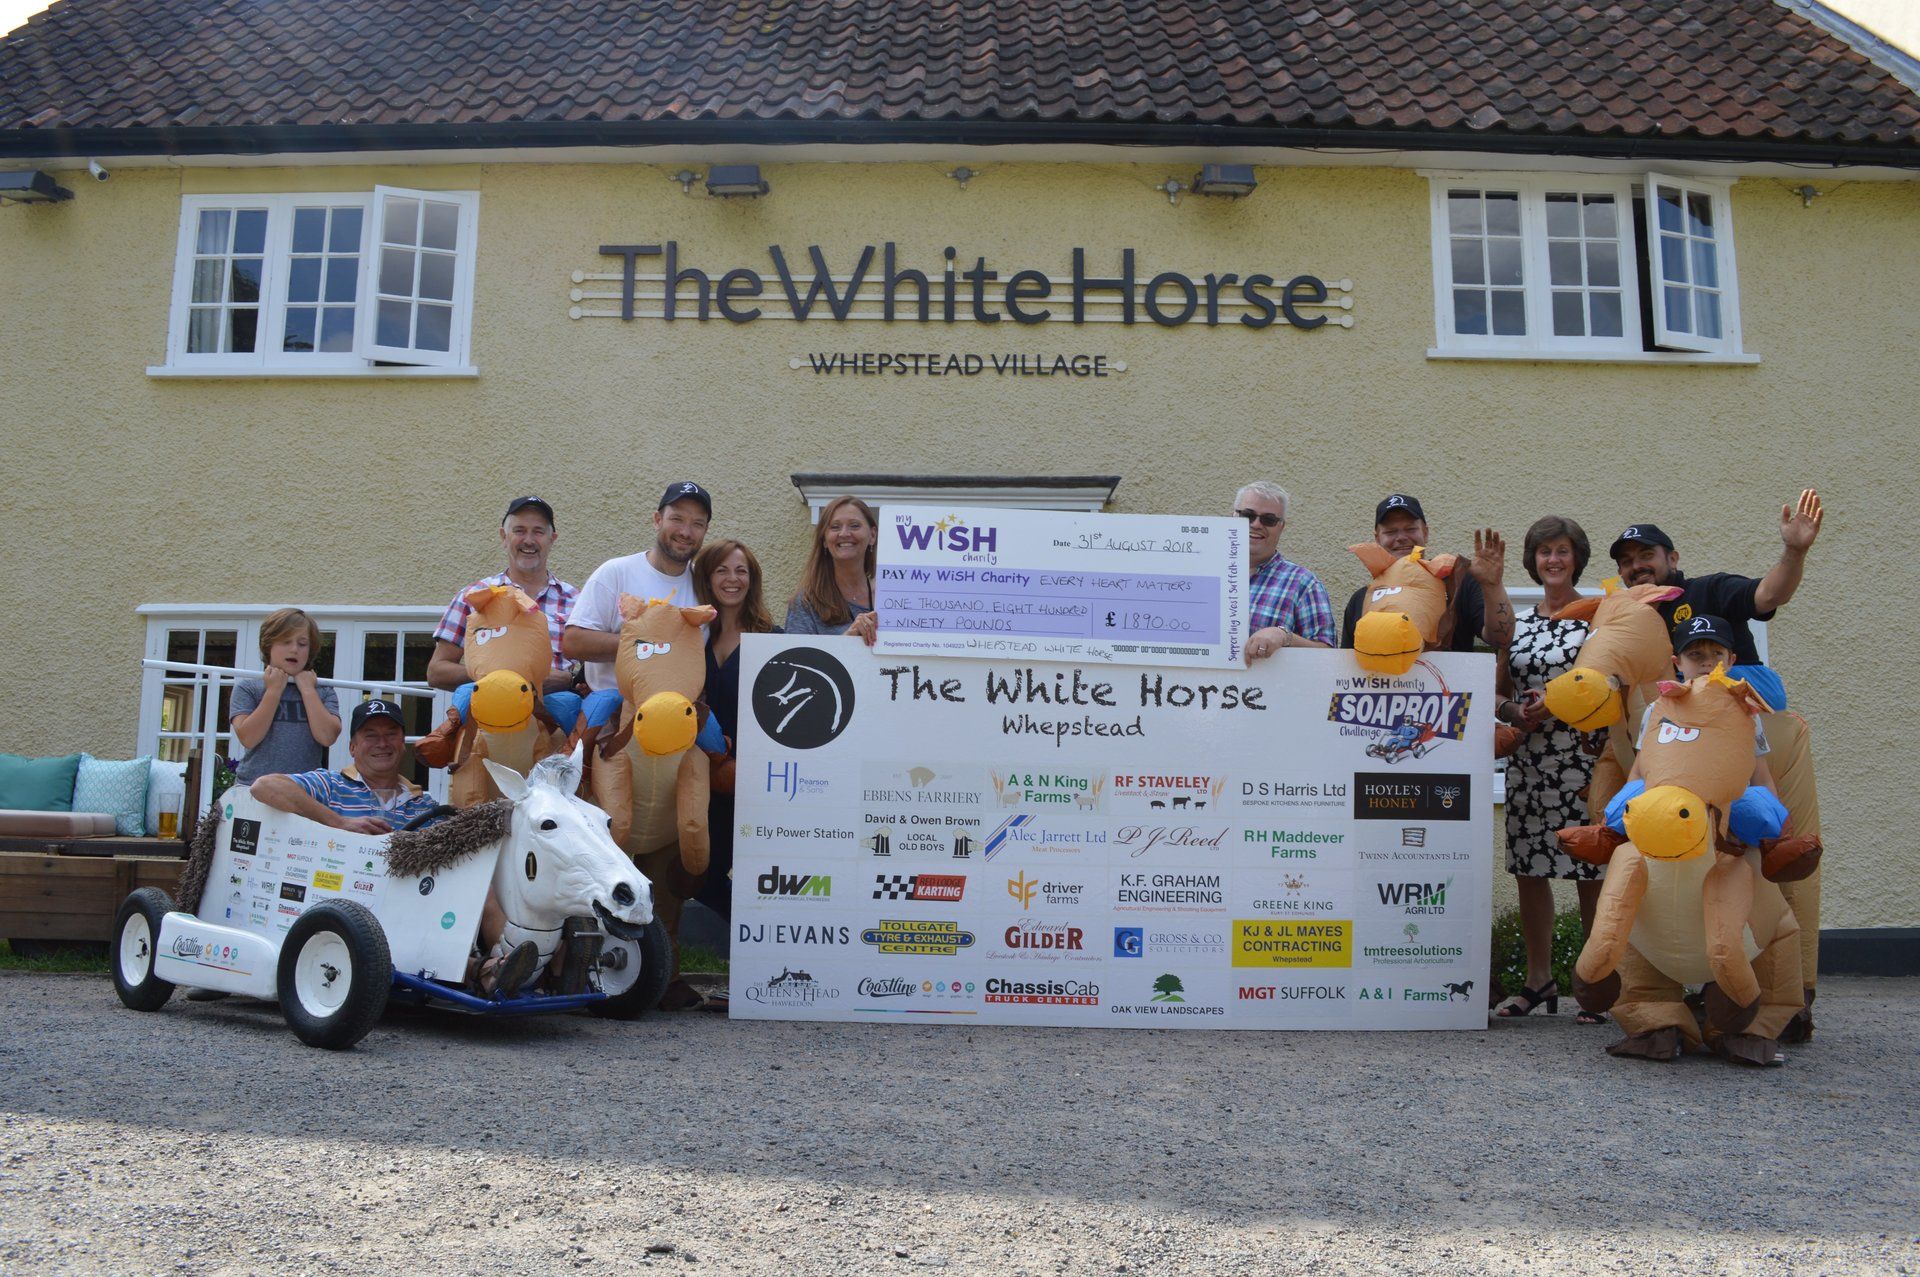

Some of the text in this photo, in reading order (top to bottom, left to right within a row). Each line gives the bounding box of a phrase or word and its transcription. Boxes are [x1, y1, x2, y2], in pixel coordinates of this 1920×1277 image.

[808, 352, 1109, 377] WHEPSTEAD VILLAGE
[895, 513, 912, 526] my
[1053, 539, 1072, 549] Date
[1105, 537, 1158, 553] AUGUST
[1162, 538, 1194, 554] 2018
[962, 553, 998, 566] charity
[882, 568, 907, 580] PAY
[910, 569, 932, 584] My
[980, 571, 1031, 588] Charity
[1039, 574, 1085, 588] EVERY
[1091, 576, 1132, 591] HEART
[1136, 578, 1194, 592] MATTERS
[1227, 528, 1241, 662] Supporting West Suffolk Hospital
[883, 597, 912, 610] ONE
[992, 600, 1034, 614] EIGHT
[1037, 602, 1089, 616] HUNDRED
[895, 616, 1013, 631] NINETY POUNDS
[912, 641, 931, 649] Charity
[966, 638, 1038, 652] WHEPSTEAD
[1043, 644, 1083, 655] WHITE
[879, 665, 1268, 711] The White Horse
[1335, 678, 1350, 691] my
[1392, 677, 1426, 692] charity
[1340, 694, 1460, 734] SOAPBOX
[1002, 713, 1146, 748] Whepstead
[1339, 725, 1382, 740] Challenge
[766, 761, 798, 801] HJ
[799, 777, 829, 786] Pearson
[1007, 774, 1089, 791] A & N King
[1114, 775, 1211, 789] RF STAVELEY
[863, 789, 982, 804] EBBENS FARRIERY
[1024, 789, 1072, 803] Farms
[1242, 782, 1347, 797] D S Harris Ltd
[1365, 784, 1421, 796] HOYLE'S
[1369, 798, 1417, 809] HONEY
[865, 813, 981, 826] David & Owen Brown
[756, 826, 855, 840] Ely Power Station
[907, 833, 938, 842] LOCAL
[1009, 828, 1107, 845] Alec Jarrett Ltd
[1163, 825, 1230, 847] Reed
[1272, 830, 1345, 844] Maddever
[899, 842, 945, 852] OLD BOYS
[1271, 846, 1317, 859] Farms
[1042, 881, 1084, 894] driver
[1120, 874, 1221, 888] K.F. GRAHAM
[916, 885, 962, 898] KARTING
[1117, 889, 1223, 904] ENGINEERING
[1377, 882, 1446, 906] WRM
[1046, 893, 1080, 905] farms
[1252, 899, 1334, 911] GREENE KING
[1405, 906, 1445, 915] AGRI LTD
[881, 921, 955, 932] TOLLGATE
[1243, 925, 1343, 938] KJ & JL MAYES
[776, 924, 850, 945] EVANS
[873, 933, 963, 944] TYRE & EXHAUST
[1149, 933, 1225, 944] GROSS & CO.
[881, 945, 955, 954] CENTRE
[1242, 940, 1343, 952] CONTRACTING
[1363, 944, 1463, 956] tmtreesolutions
[1272, 955, 1313, 964] Whepstead
[1373, 957, 1412, 965] Professional
[857, 976, 917, 998] Coastline
[985, 977, 1100, 996] ChassisCab
[1238, 986, 1346, 1000] MGT SUFFOLK
[986, 995, 1097, 1005] TRUCK CENTRES
[1359, 987, 1448, 1001] A & Farms
[1111, 1005, 1224, 1015] OAK VIEW LANDSCAPES
